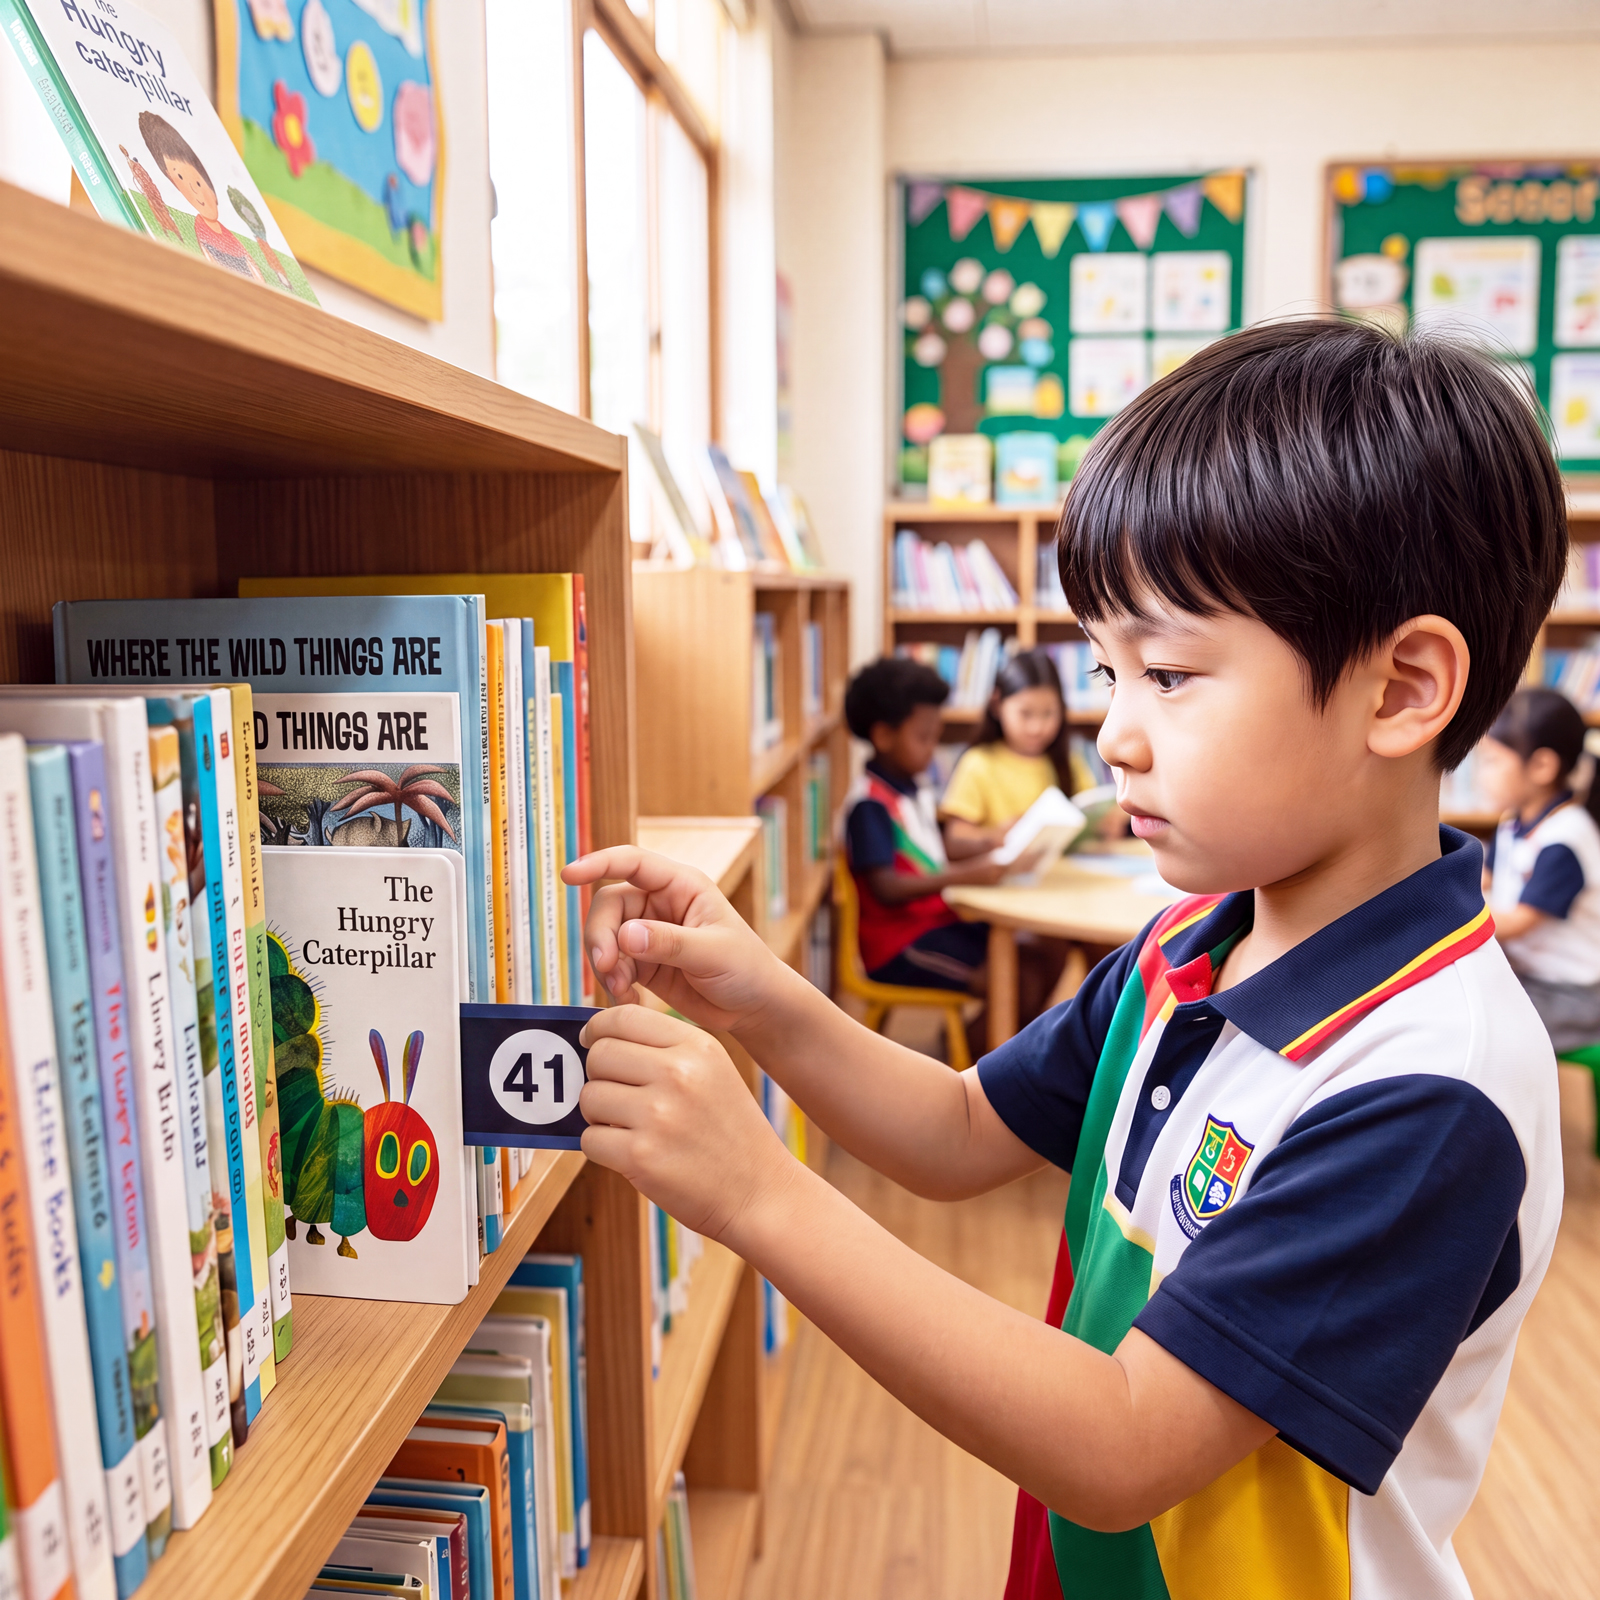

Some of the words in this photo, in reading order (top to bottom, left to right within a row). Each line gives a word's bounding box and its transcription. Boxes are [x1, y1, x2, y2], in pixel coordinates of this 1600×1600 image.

[60, 0, 167, 78] Hungry
[75, 40, 194, 117] caterpillar
[86, 638, 171, 678] WHERE
[176, 638, 222, 677] THE
[228, 637, 287, 678] WILD
[294, 636, 384, 677] THINGS
[392, 636, 442, 676] ARE
[275, 710, 369, 752] THINGS
[376, 711, 429, 751] ARE
[383, 875, 434, 903] The
[336, 906, 435, 941] Hungry
[302, 938, 437, 975] Caterpillar
[502, 1051, 565, 1104] 41
